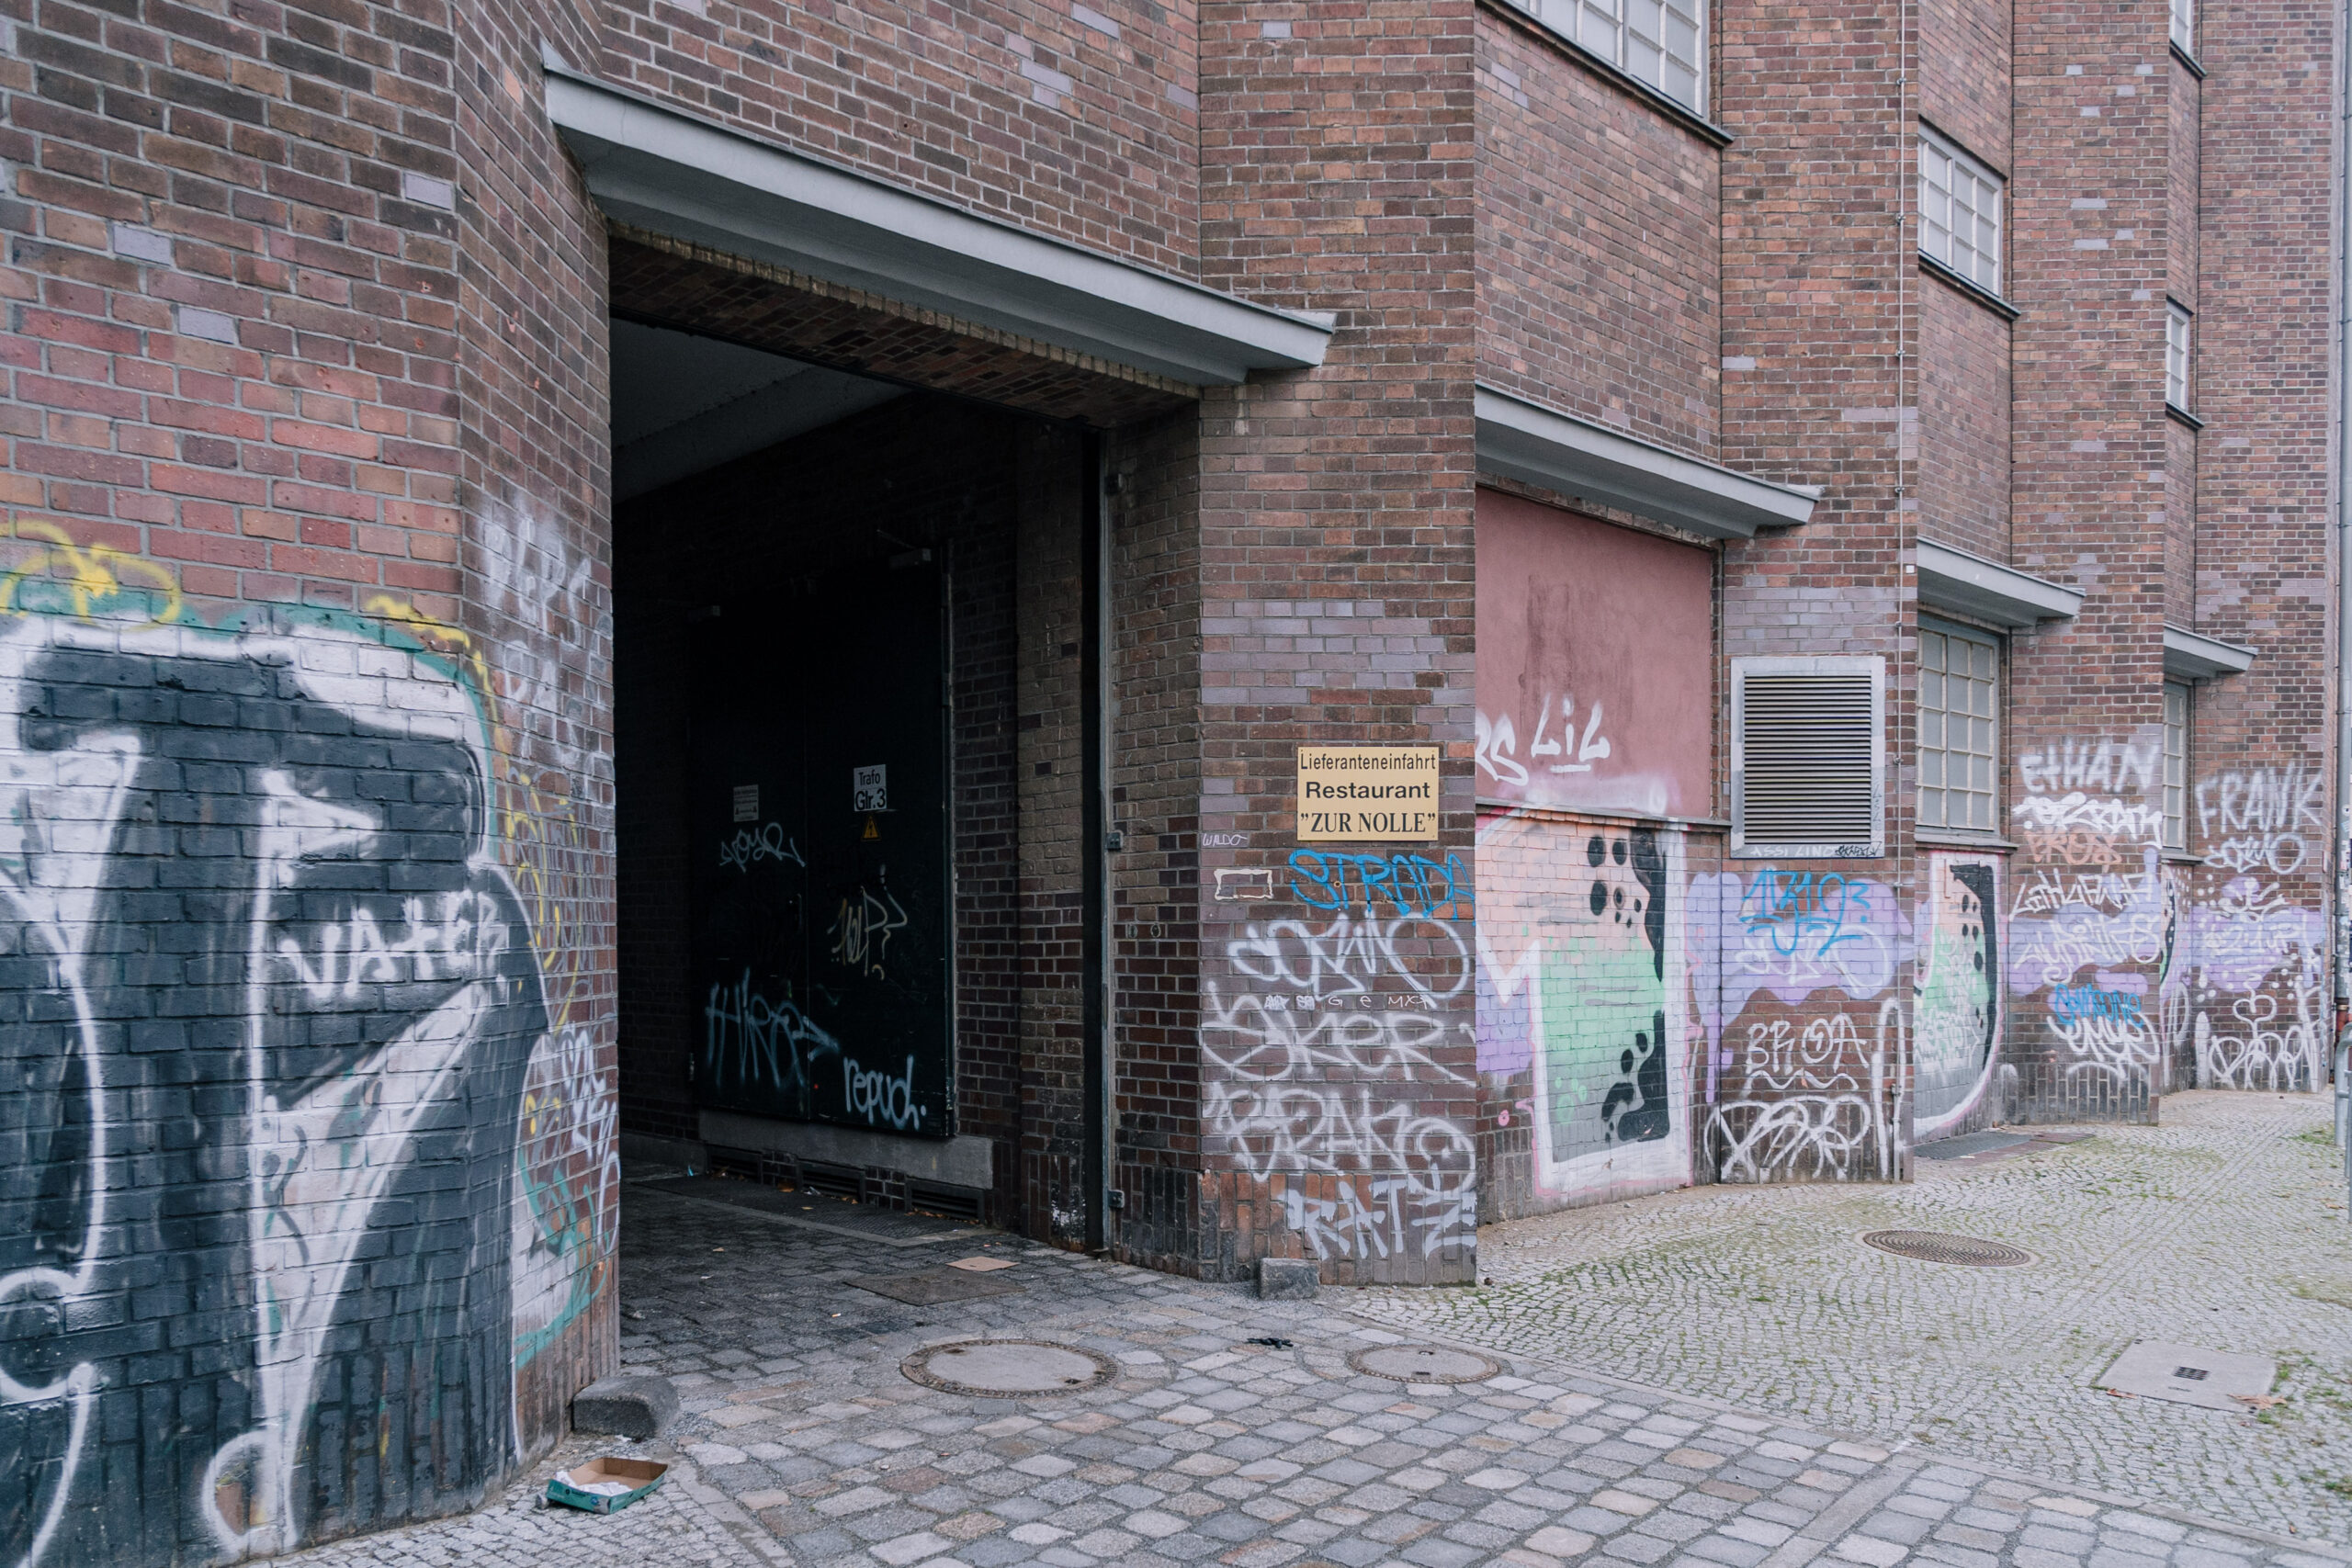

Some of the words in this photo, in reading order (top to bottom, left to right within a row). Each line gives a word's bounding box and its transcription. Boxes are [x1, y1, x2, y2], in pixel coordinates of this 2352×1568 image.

[1300, 752, 1436, 771] Lieferanteneinfahrt
[858, 770, 881, 786] Trafo
[1306, 781, 1430, 799] Restaurant
